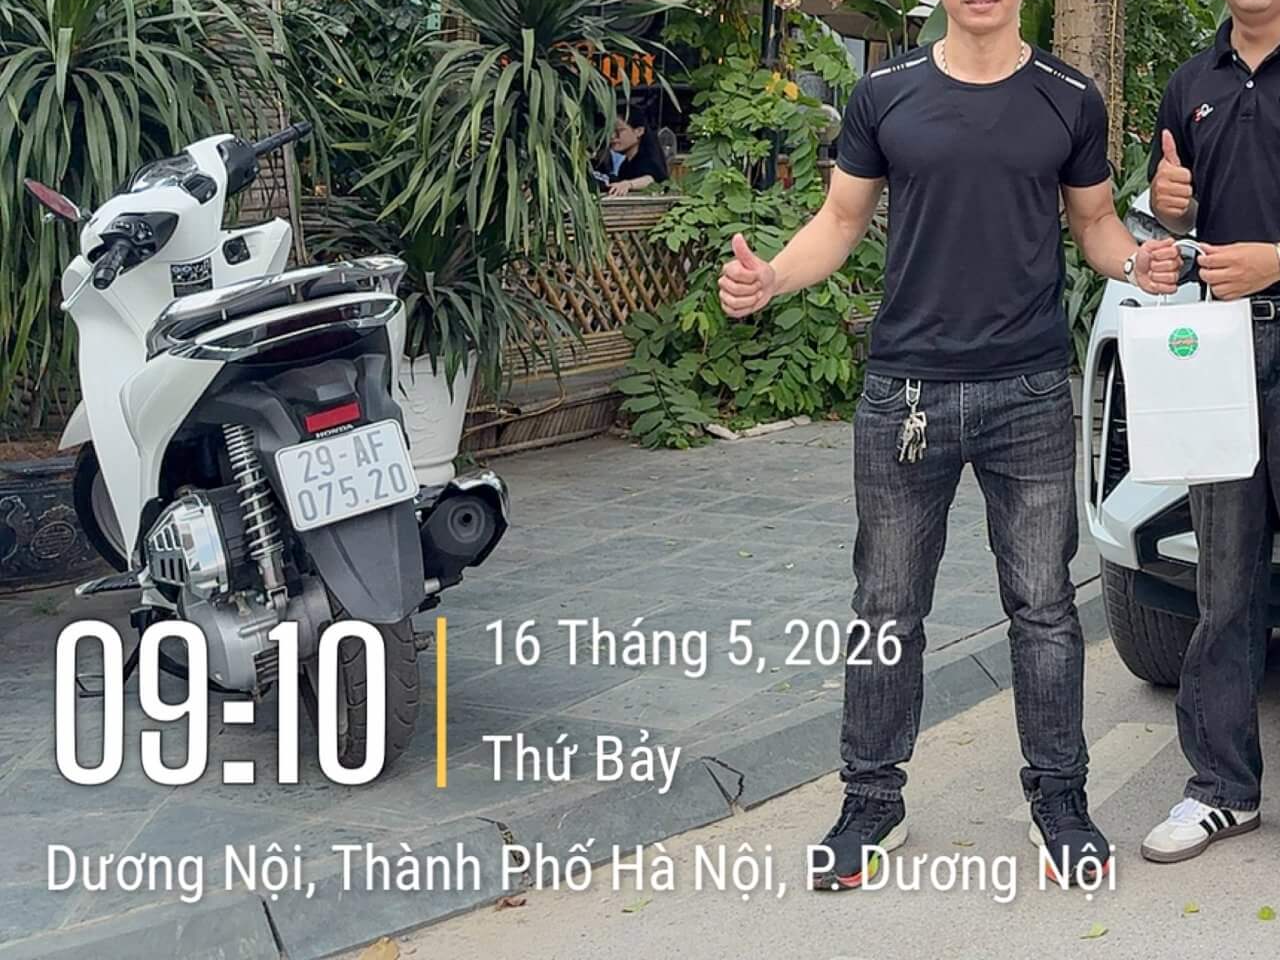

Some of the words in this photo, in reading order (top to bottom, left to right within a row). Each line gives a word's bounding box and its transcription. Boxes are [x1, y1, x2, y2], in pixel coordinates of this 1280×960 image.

[297, 430, 384, 484] 29-AF
[315, 424, 355, 439] HONDA
[297, 462, 408, 522] 075.20
